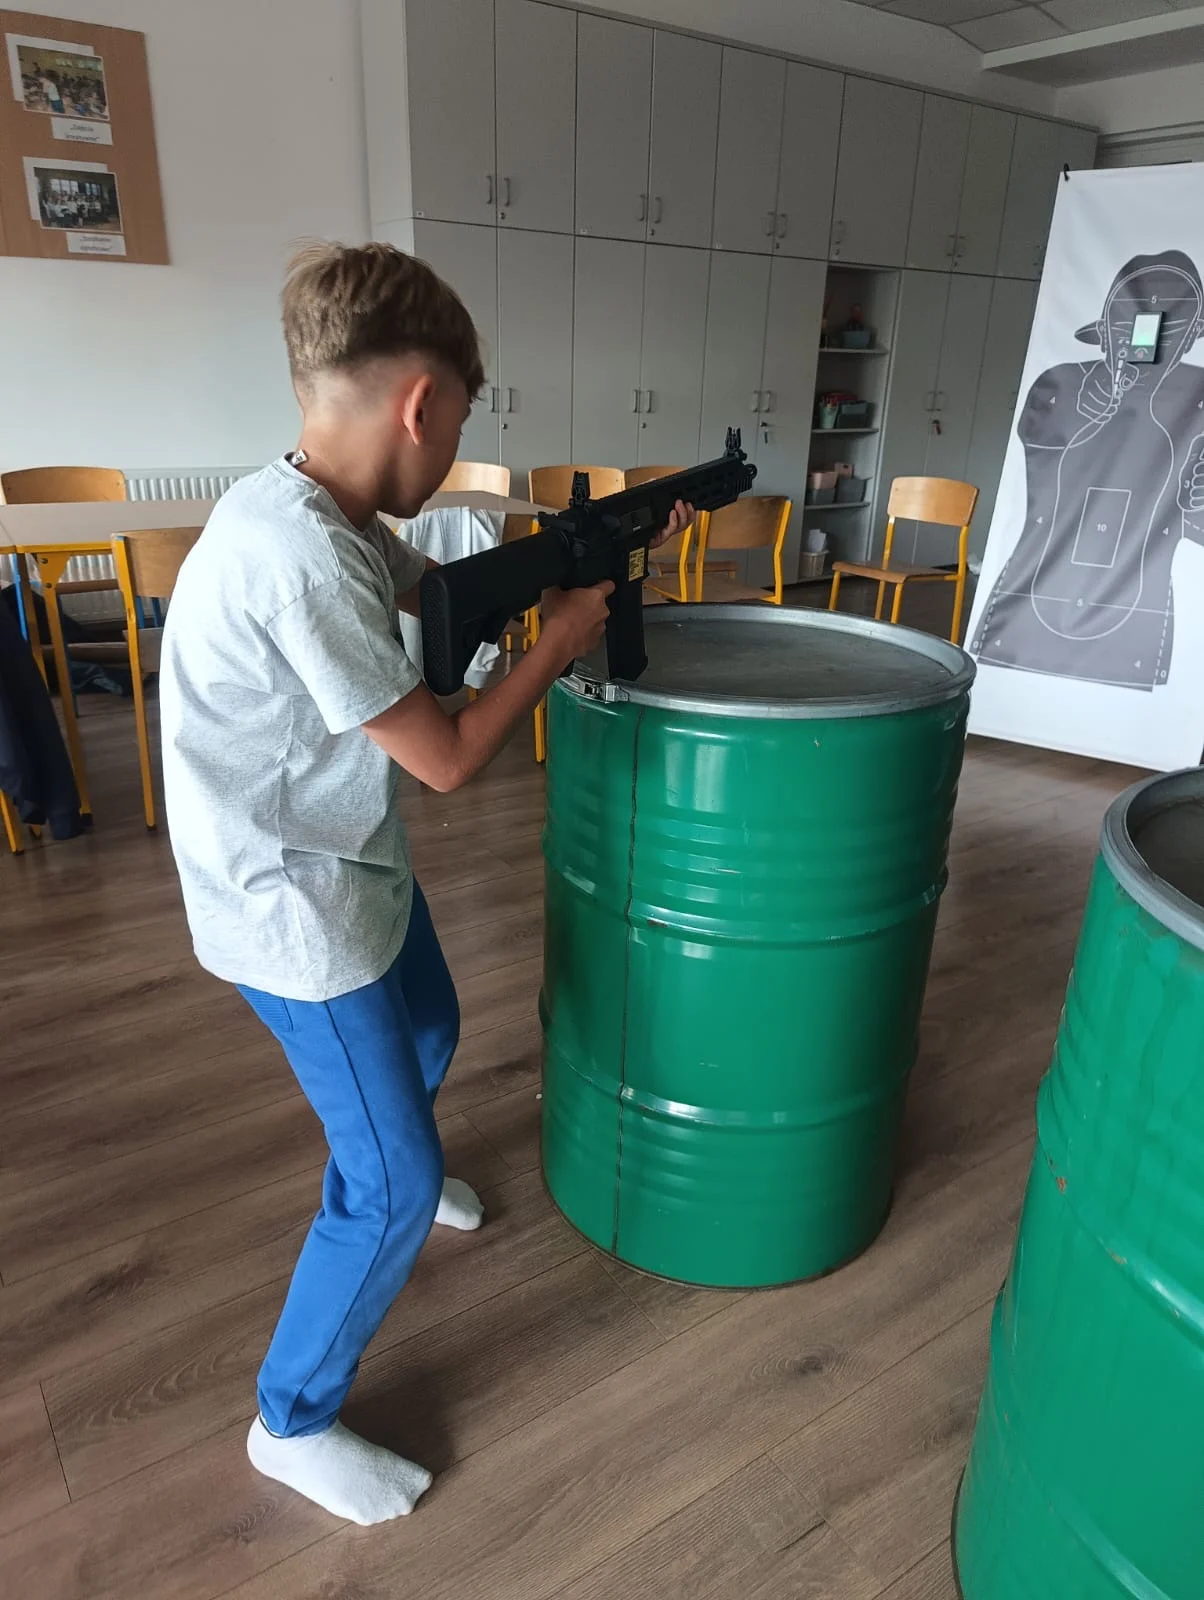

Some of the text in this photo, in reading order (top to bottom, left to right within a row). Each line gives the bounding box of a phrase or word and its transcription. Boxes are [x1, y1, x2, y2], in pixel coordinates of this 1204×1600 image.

[1050, 396, 1056, 404] 4
[1037, 516, 1043, 524] 4
[1097, 523, 1107, 532] 10
[1162, 527, 1169, 535] 4
[973, 640, 979, 649] 0
[995, 639, 1001, 647] 4
[1134, 660, 1141, 668] 4
[1160, 670, 1166, 678] 0
